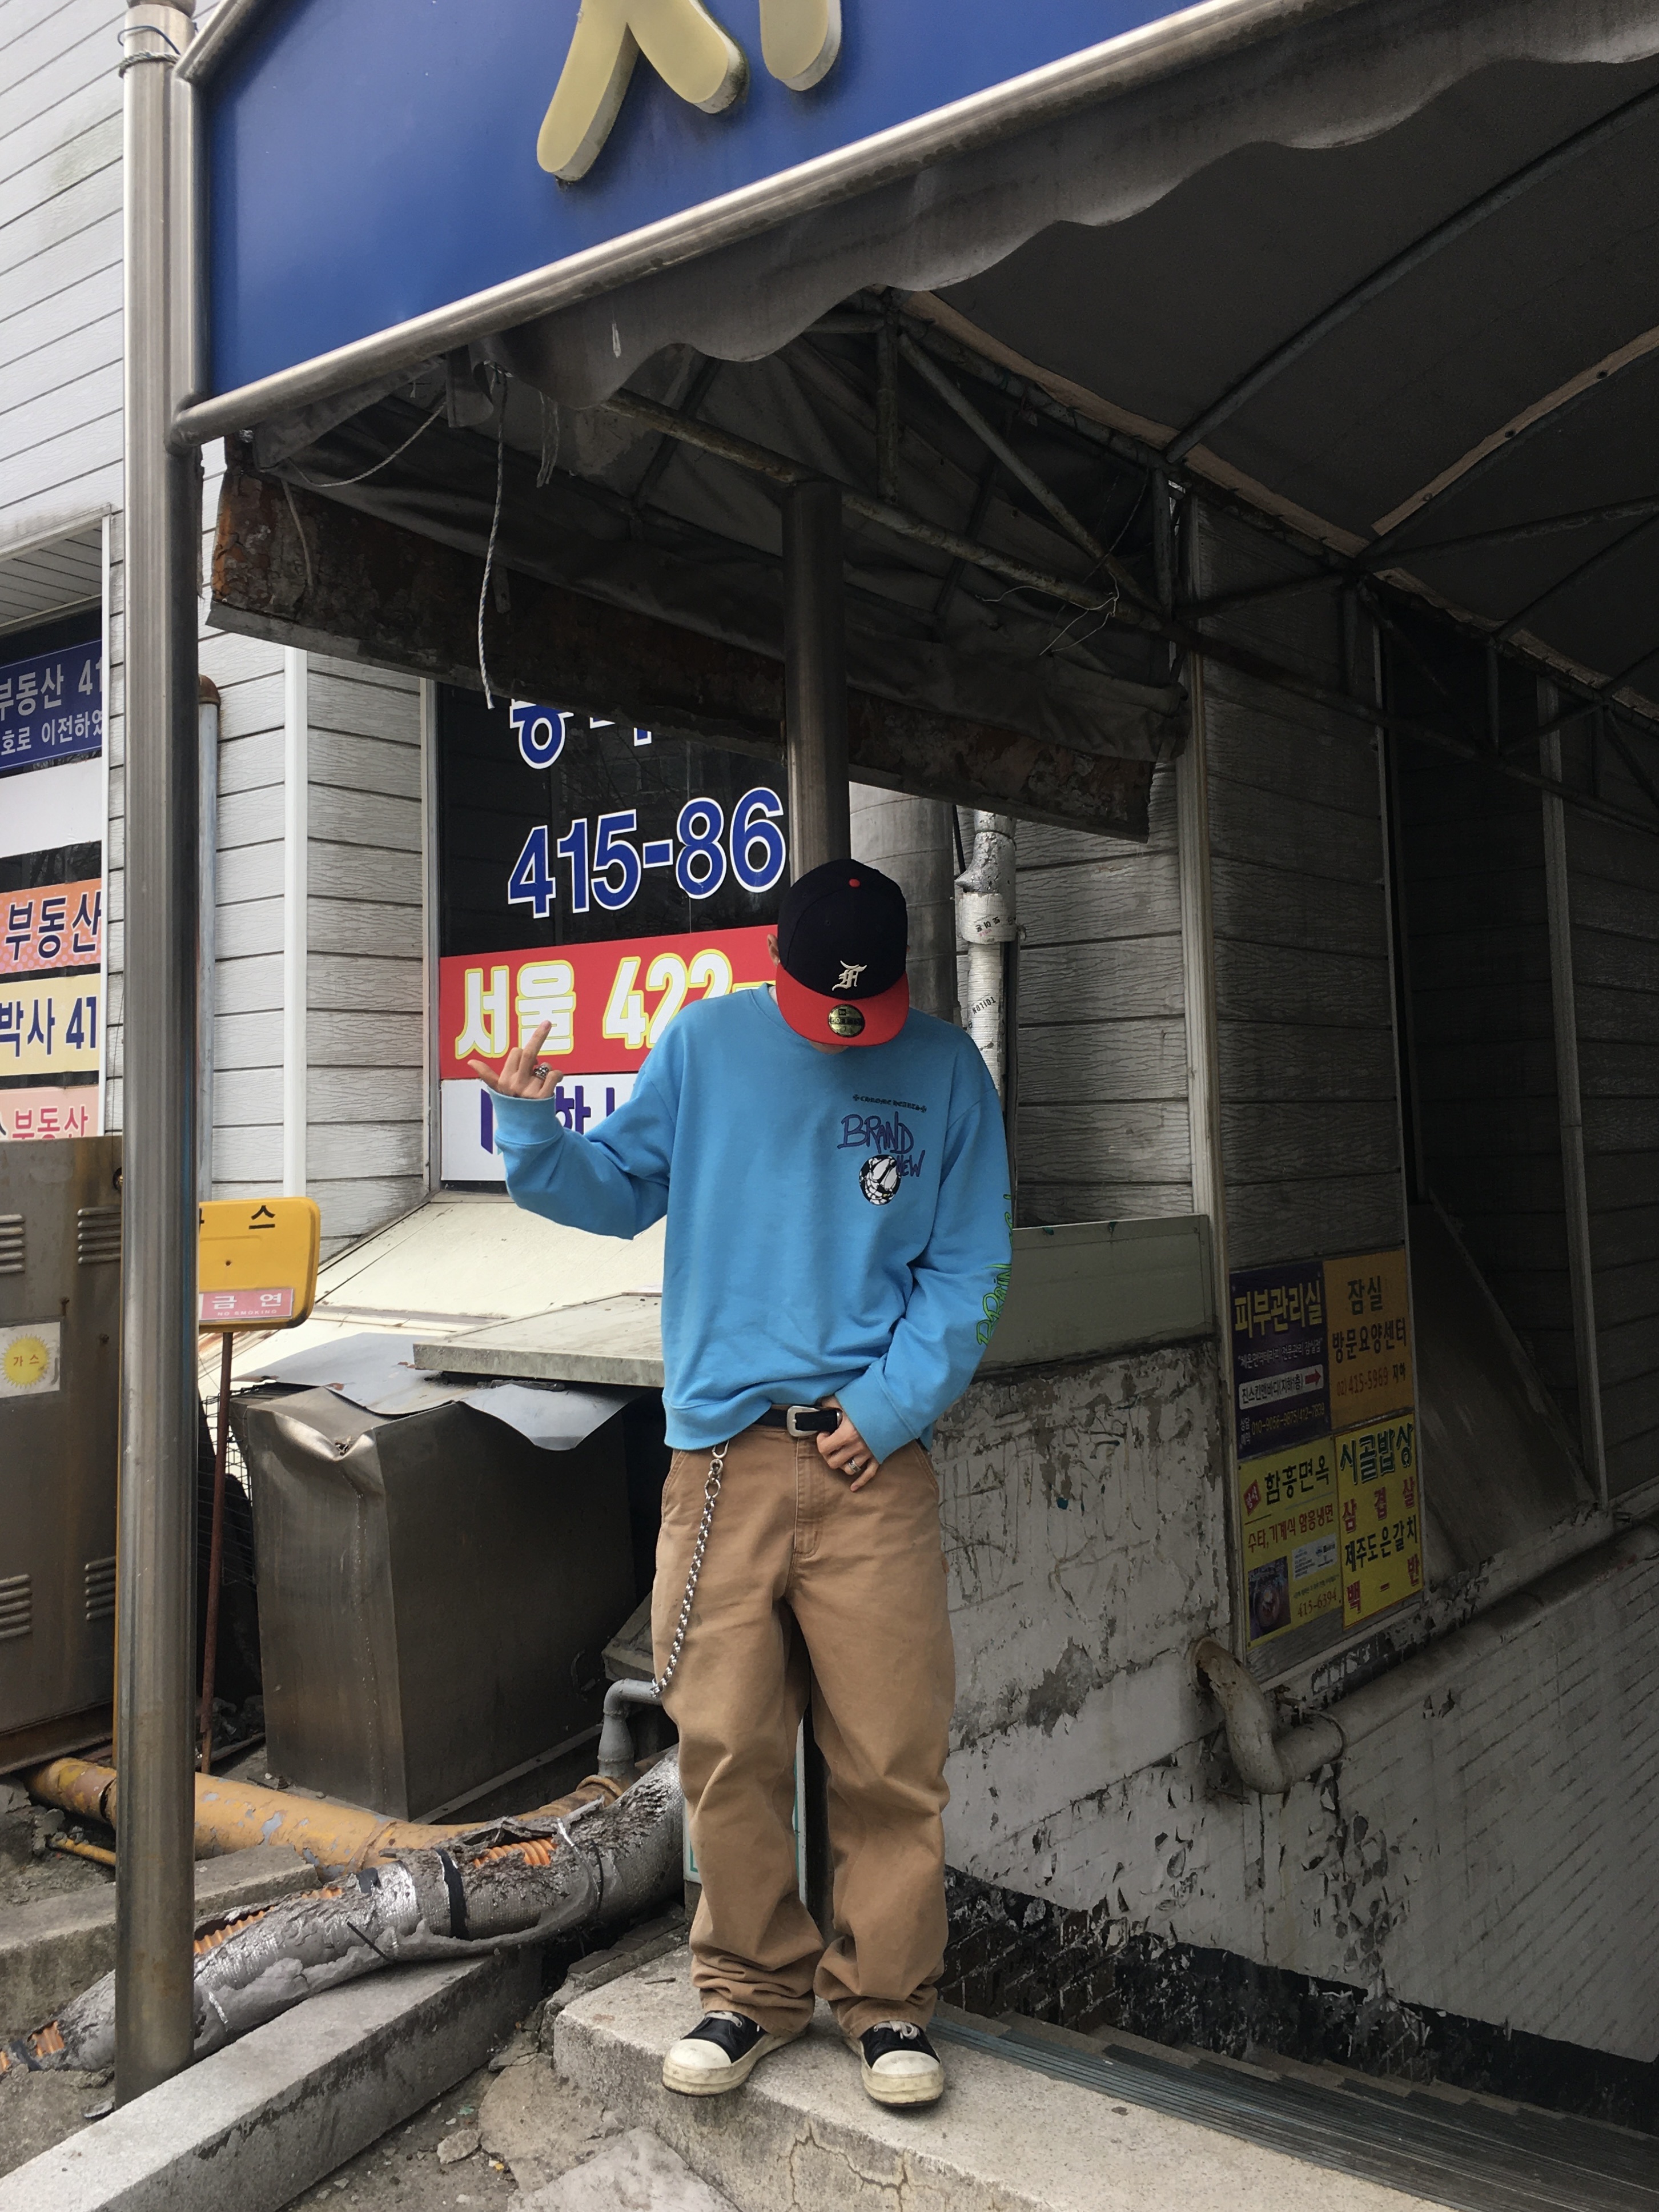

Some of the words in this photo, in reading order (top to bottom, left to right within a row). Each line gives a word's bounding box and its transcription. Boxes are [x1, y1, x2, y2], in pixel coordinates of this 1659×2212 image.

[0, 664, 64, 721] 부동산
[1, 725, 31, 756] 호로
[508, 787, 786, 919] 415-86
[5, 890, 102, 962] 부동산
[0, 997, 55, 1058] 박사
[65, 995, 97, 1050] 41
[455, 958, 576, 1060] 서울
[837, 1111, 914, 1154] BRAND
[896, 1150, 926, 1178] NEW
[1234, 1279, 1323, 1339] 피부관리실
[1347, 1275, 1383, 1315] 잠실
[13, 1354, 40, 1367] 가스
[1332, 1317, 1407, 1364] 방문요양센터
[1339, 1422, 1413, 1485] 시골밥상
[1264, 1455, 1329, 1506] 함흥면옥
[1297, 1587, 1337, 1617] 415-6394
